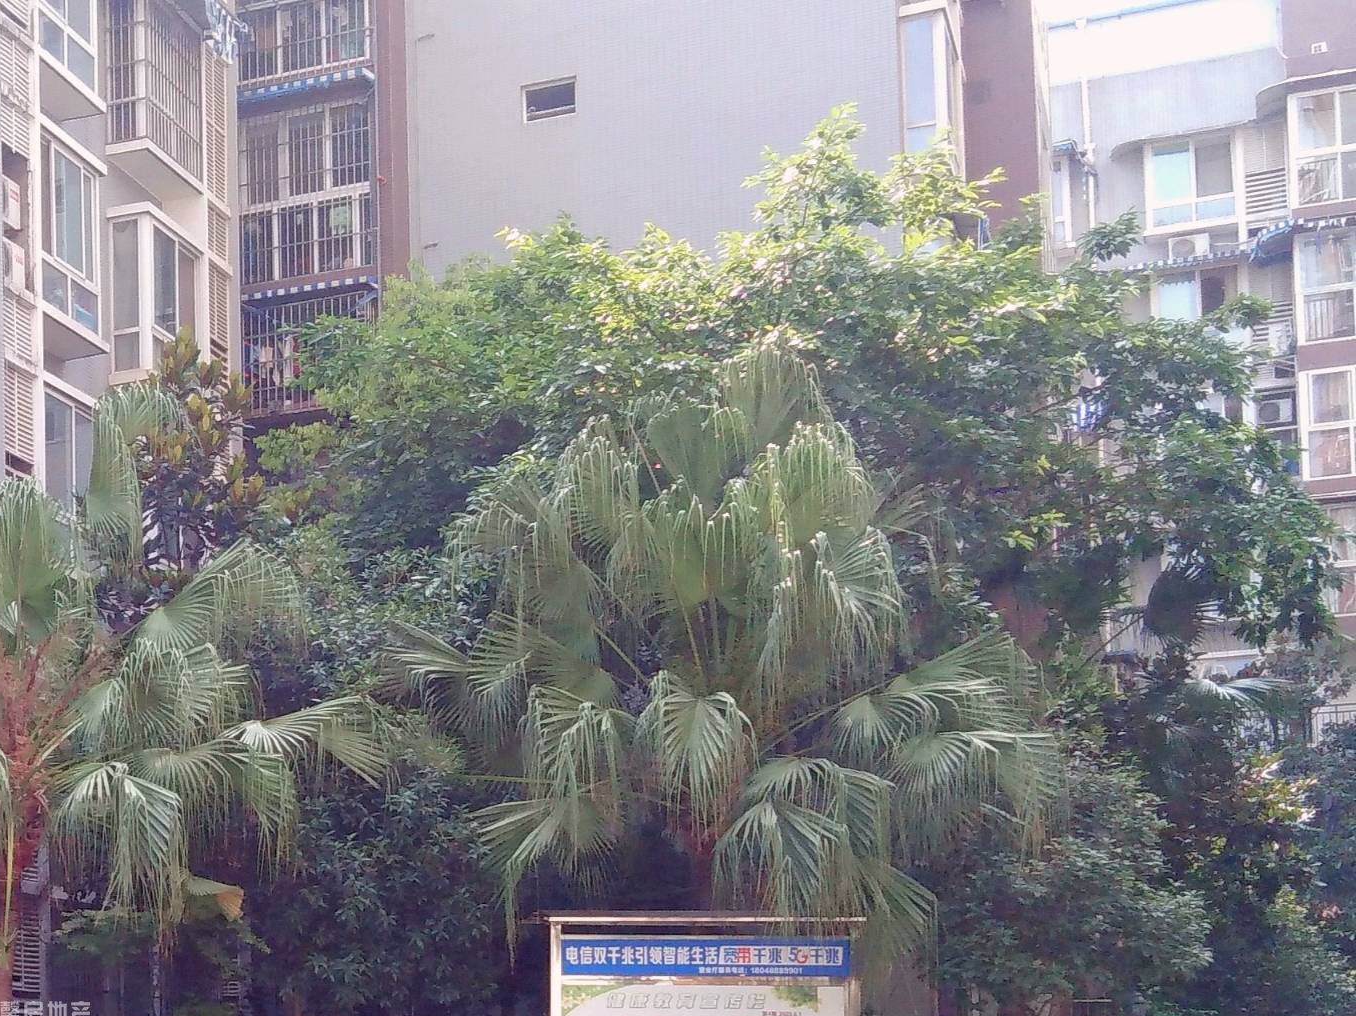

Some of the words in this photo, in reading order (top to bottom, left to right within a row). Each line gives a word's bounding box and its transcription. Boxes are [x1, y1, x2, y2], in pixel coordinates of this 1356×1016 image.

[566, 946, 718, 965] 电信双千兆引领智能生活
[607, 993, 766, 1010] 健康教育宣传栏
